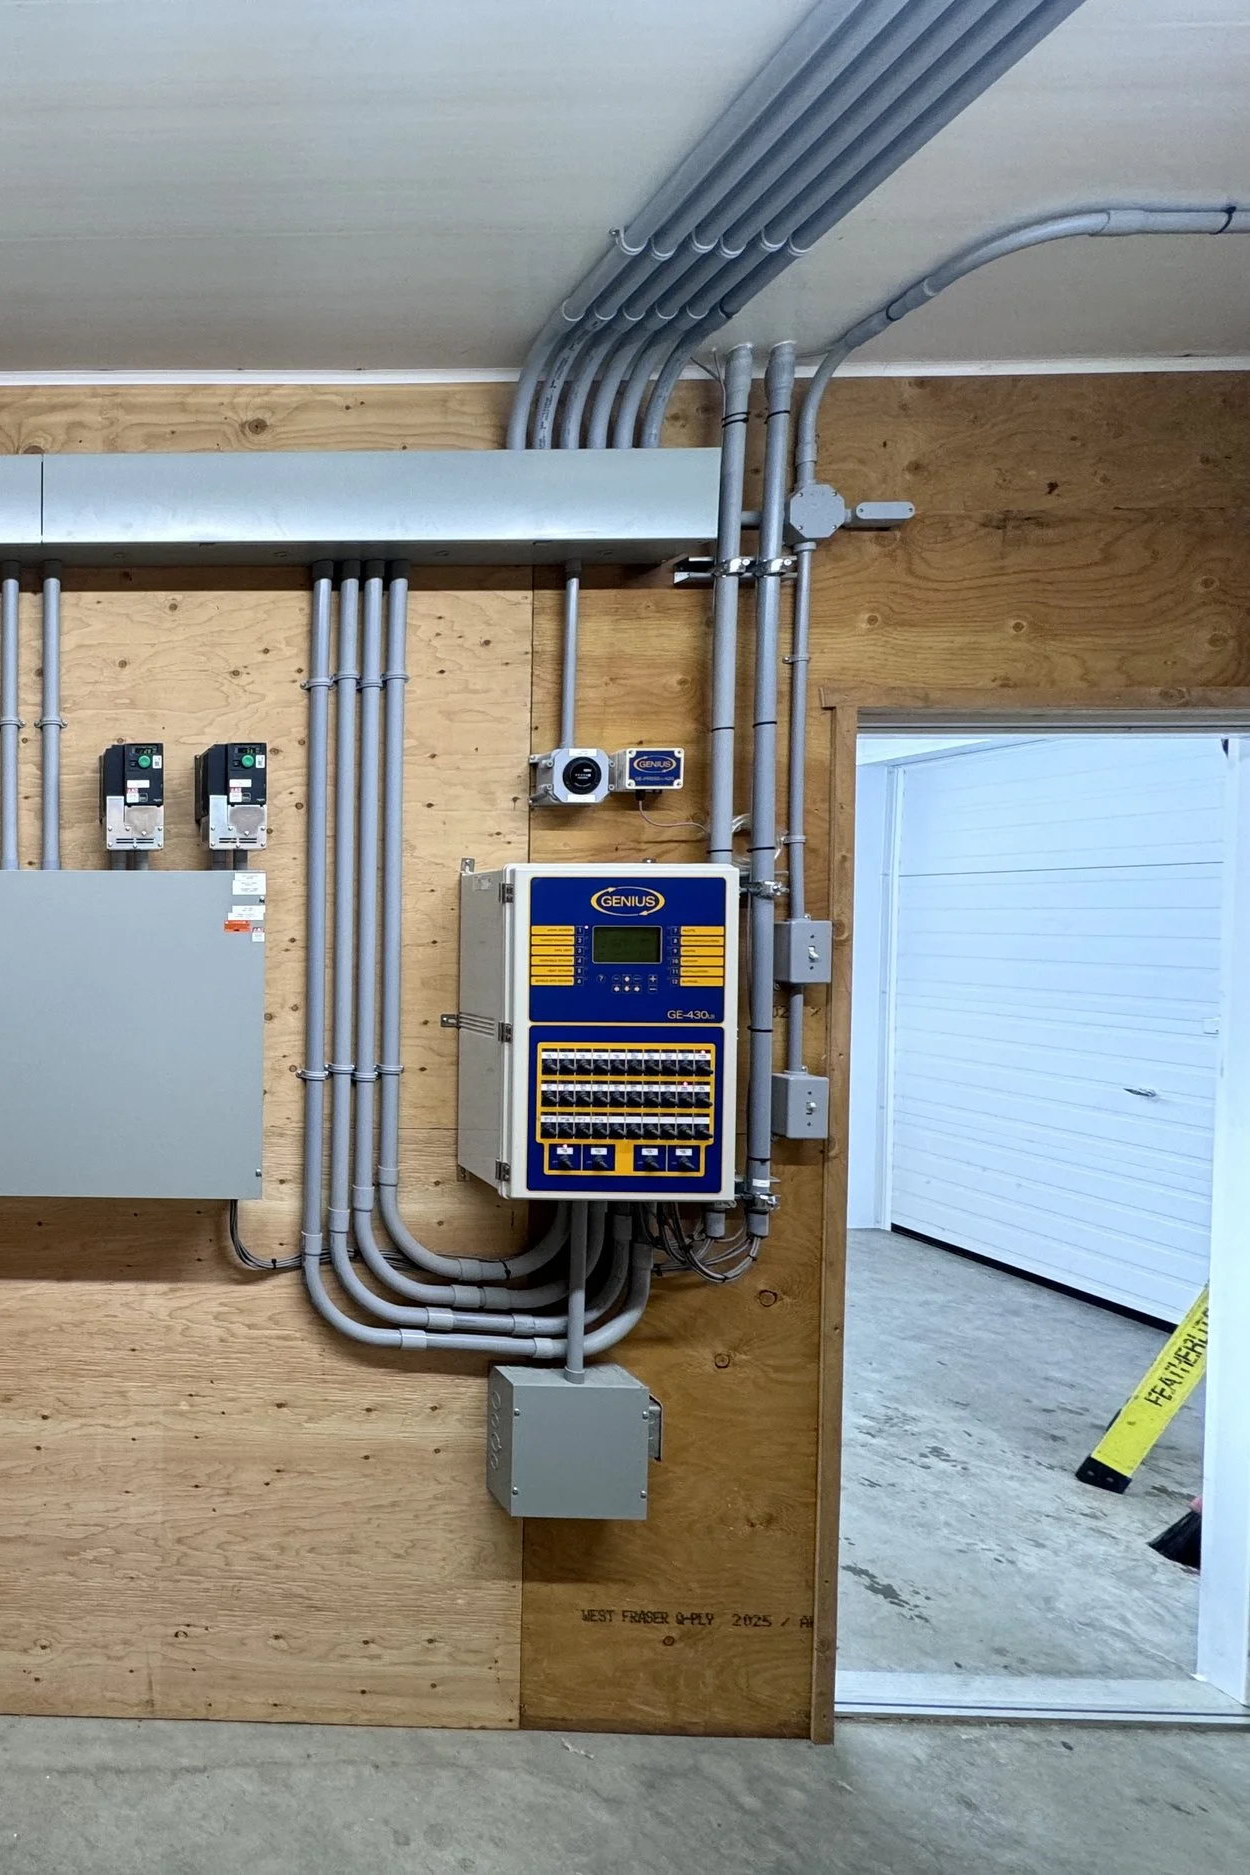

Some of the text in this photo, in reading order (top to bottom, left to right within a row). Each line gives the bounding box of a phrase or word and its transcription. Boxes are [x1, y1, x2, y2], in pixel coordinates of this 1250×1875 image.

[639, 760, 671, 768] GENIUS
[601, 895, 656, 907] GENIUS
[581, 1609, 615, 1623] WEST
[621, 1610, 670, 1624] FRASER
[731, 1613, 772, 1627] 2025
